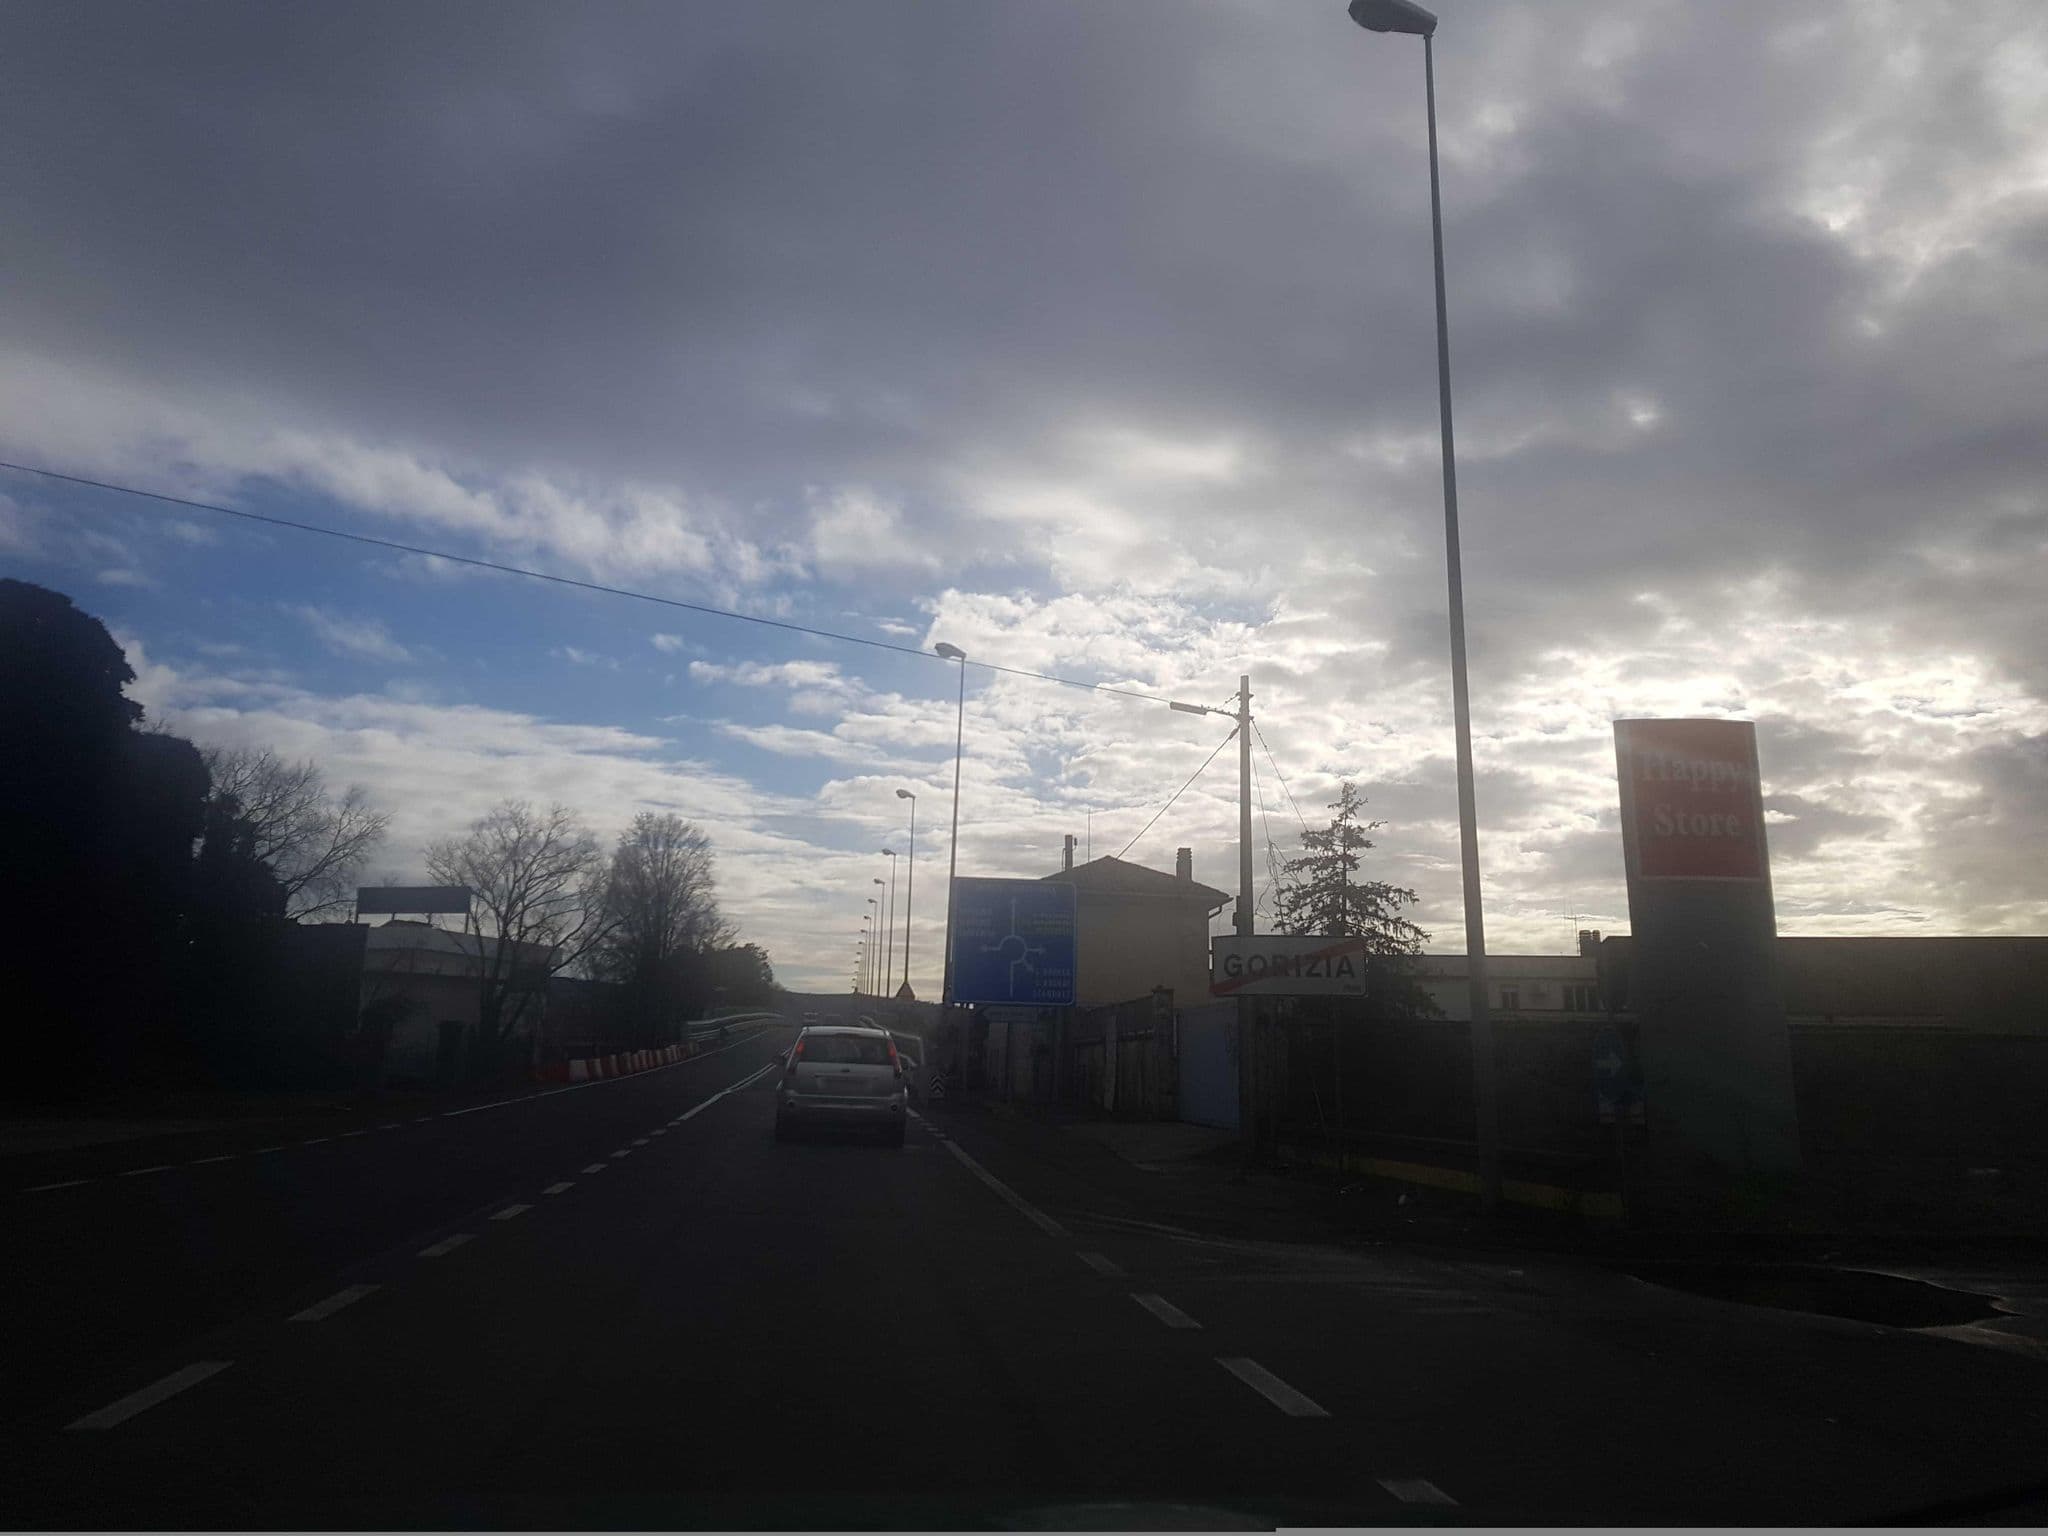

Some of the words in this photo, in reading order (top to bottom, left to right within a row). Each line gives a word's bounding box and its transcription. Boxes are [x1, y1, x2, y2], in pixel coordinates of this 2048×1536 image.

[1640, 752, 1744, 792] Happy
[1654, 803, 1740, 837] Store
[1223, 953, 1355, 978] GORIZIA
